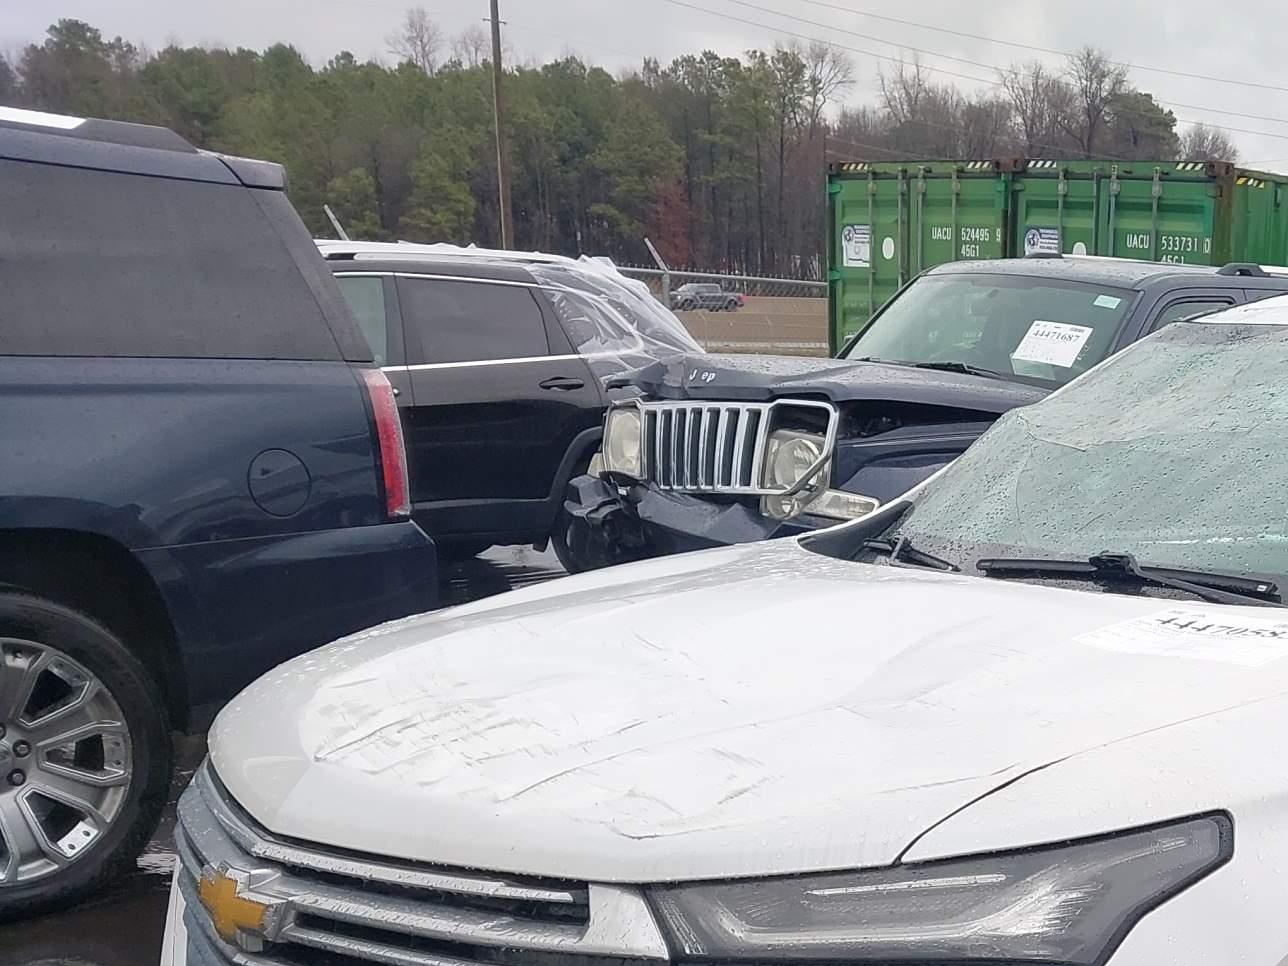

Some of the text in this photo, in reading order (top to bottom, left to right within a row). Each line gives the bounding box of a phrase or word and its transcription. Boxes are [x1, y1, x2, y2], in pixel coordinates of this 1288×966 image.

[932, 226, 1001, 242] UACU 524495 9
[961, 244, 980, 257] 45G1
[1126, 233, 1210, 253] UACU 533731 0
[1032, 329, 1081, 343] 44471687
